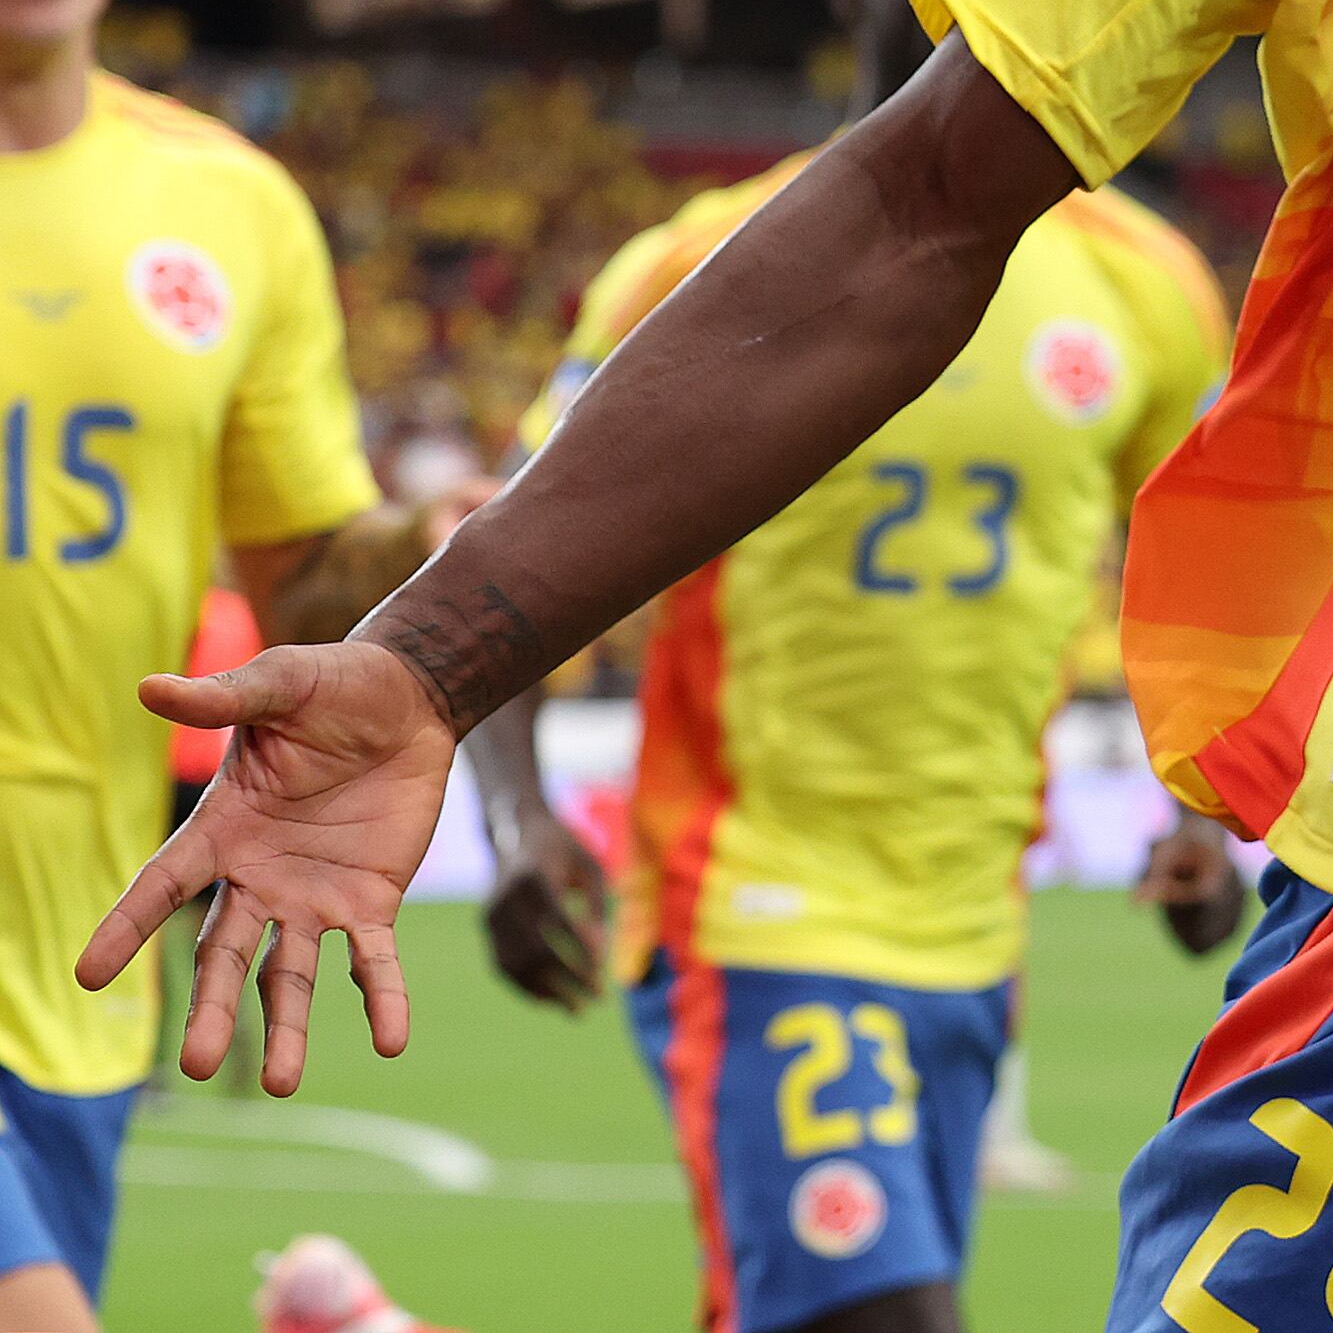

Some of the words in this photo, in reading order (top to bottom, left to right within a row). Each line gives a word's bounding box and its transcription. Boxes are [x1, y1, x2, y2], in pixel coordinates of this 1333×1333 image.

[4, 398, 137, 564] 15
[851, 460, 1022, 596] 23
[763, 1001, 922, 1162] 23
